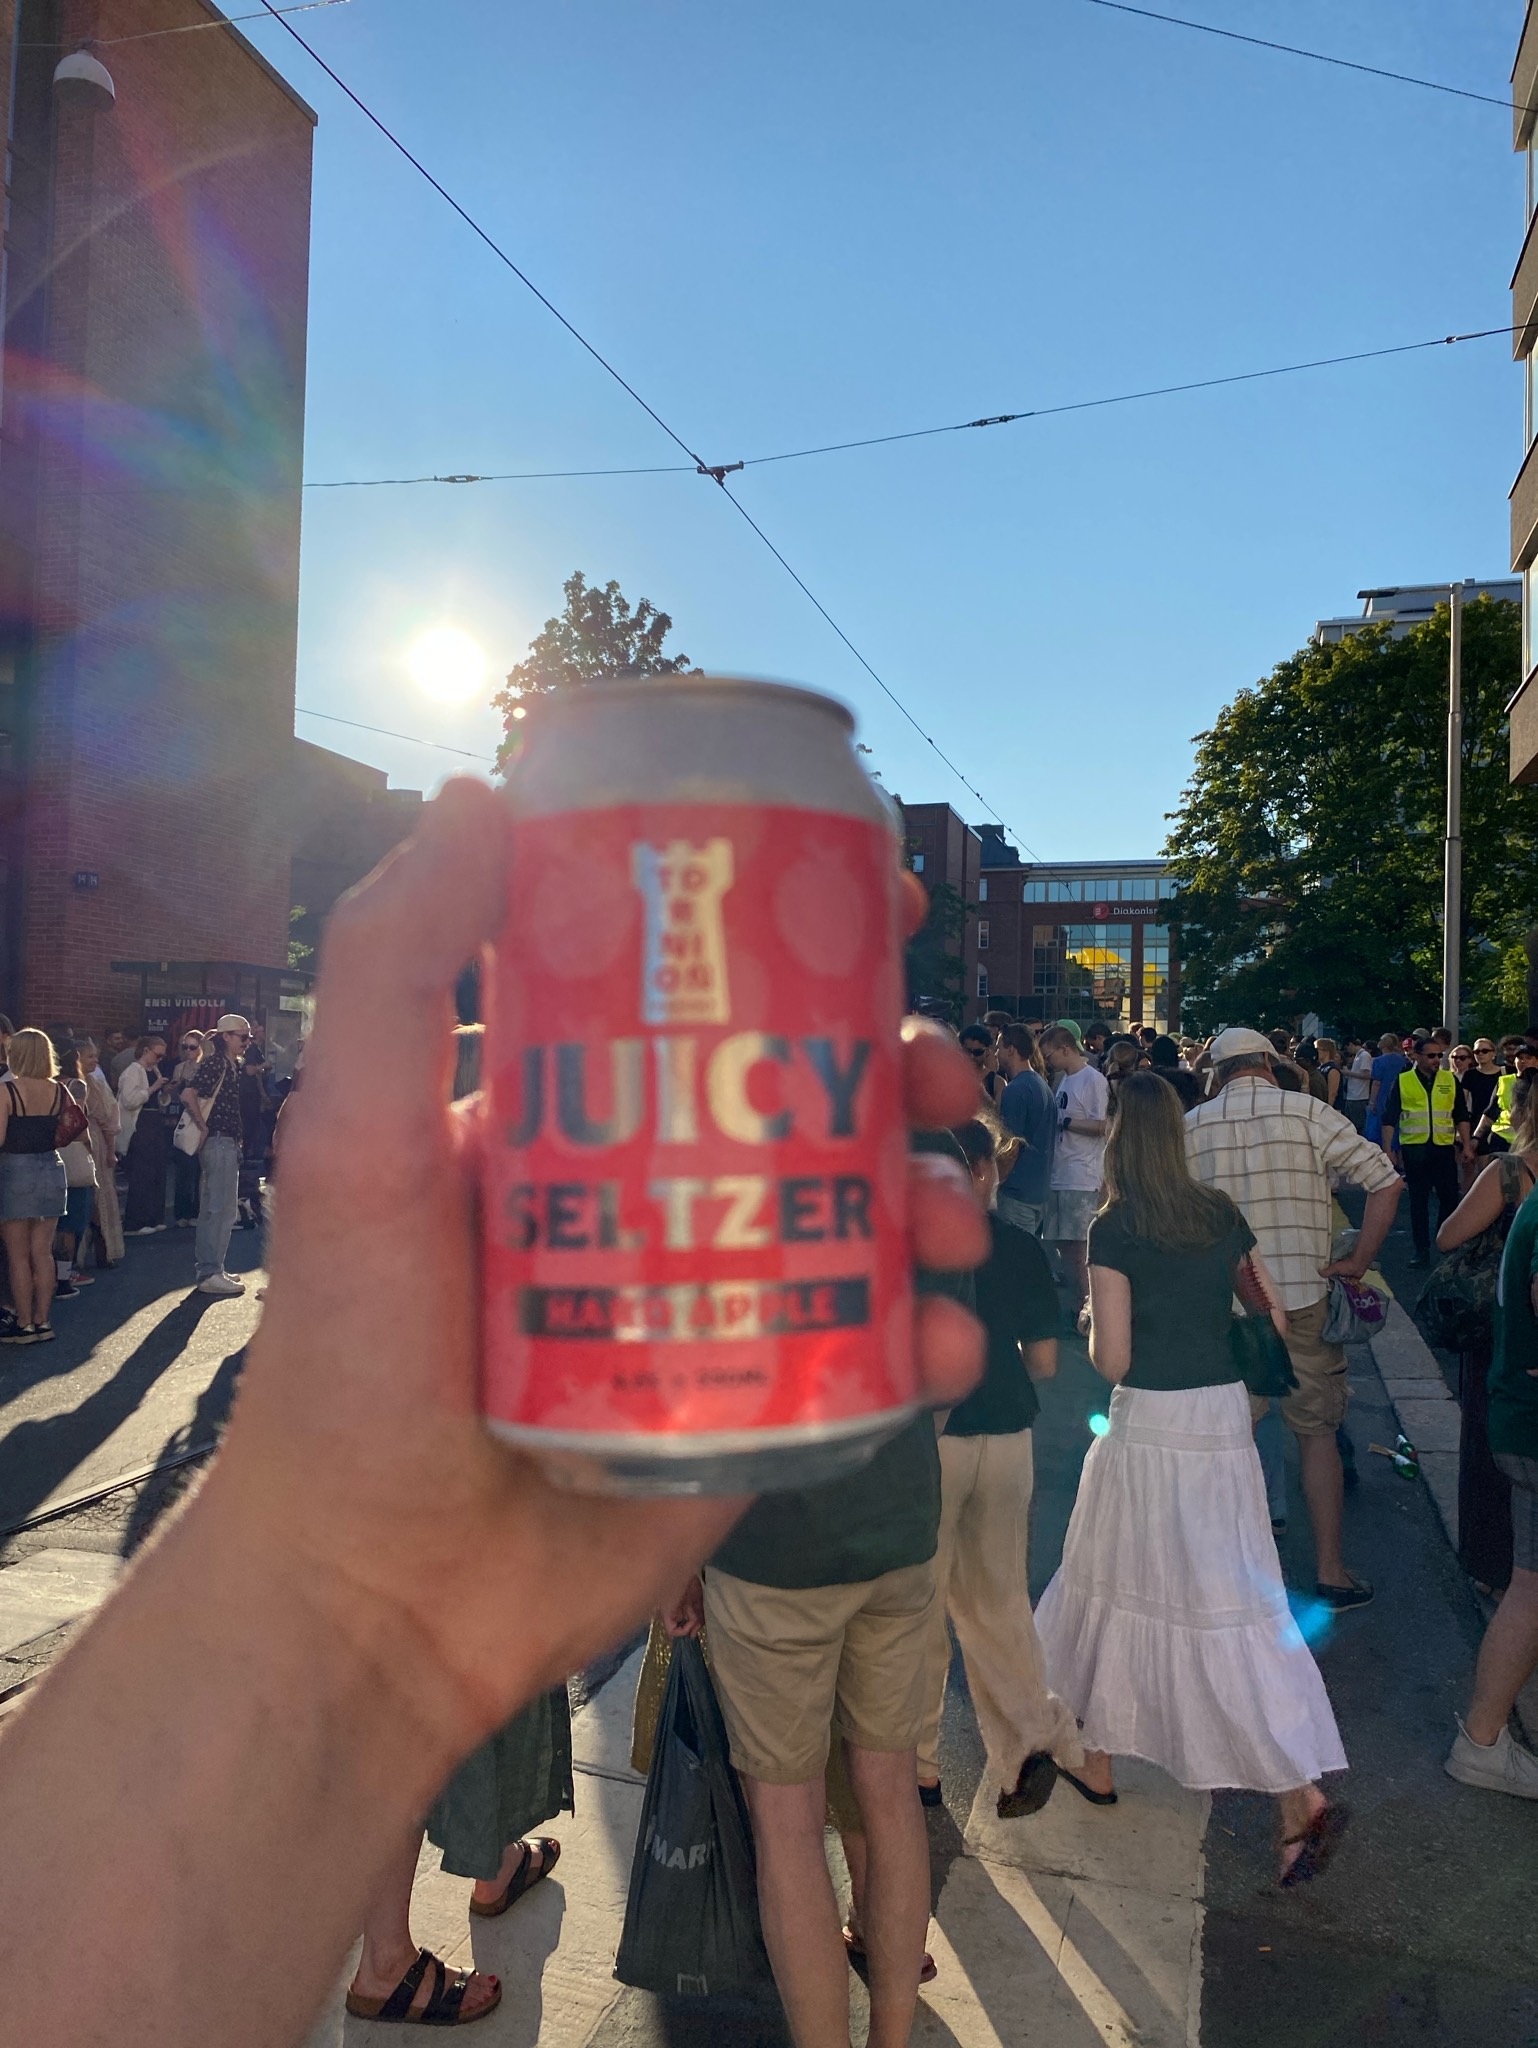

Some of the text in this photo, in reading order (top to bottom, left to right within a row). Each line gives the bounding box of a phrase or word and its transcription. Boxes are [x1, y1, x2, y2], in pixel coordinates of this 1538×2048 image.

[144, 998, 226, 1008] ENSI VIIKOLLA
[505, 1030, 872, 1150] JUICY
[505, 1174, 874, 1252] SELTZER
[648, 1827, 714, 1870] MAR
